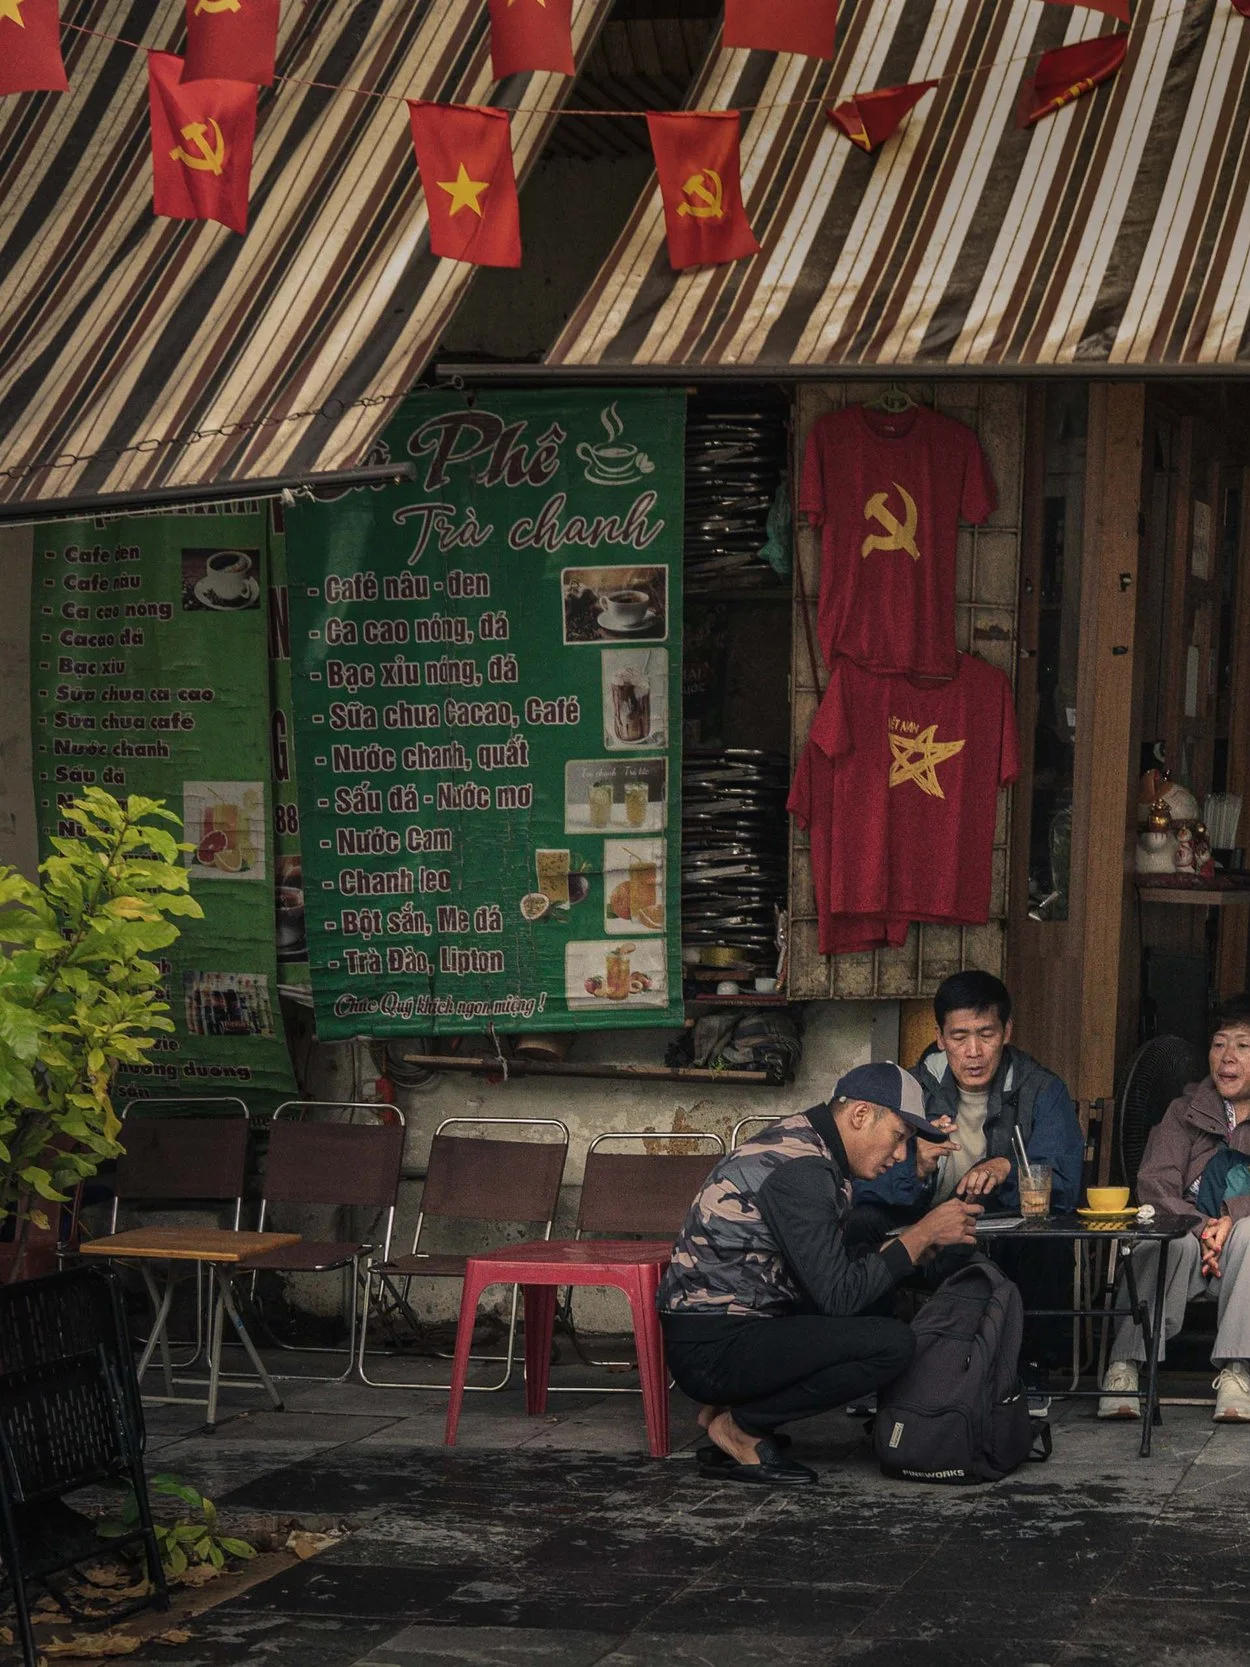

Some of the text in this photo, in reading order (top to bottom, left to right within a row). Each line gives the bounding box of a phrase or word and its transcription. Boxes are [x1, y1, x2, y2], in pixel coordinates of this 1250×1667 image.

[407, 410, 567, 492] Phê
[393, 490, 665, 566] Trà chanh
[325, 569, 490, 603] Café nâu đen
[60, 601, 90, 620] Ca
[325, 610, 509, 645] Ca cao nóng, đá
[58, 656, 97, 679] Bạc
[326, 653, 518, 693] Bạc xỉu nóng, đá
[101, 683, 146, 702] chua
[150, 688, 171, 702] ca
[177, 688, 215, 702] cao
[101, 712, 146, 731] chua
[329, 696, 580, 731] Sữa chua Cacao, Café
[112, 738, 170, 758] chanh
[331, 734, 529, 773] Nước chanh, quất
[335, 781, 533, 814] Sấu đá Nước mơ
[275, 803, 300, 835] 88
[336, 825, 452, 855] Nước Cam
[339, 866, 451, 896] Chanh leo
[341, 901, 503, 940] Bột sắn, Me đá
[344, 946, 504, 976] Trà Đào, Lipton
